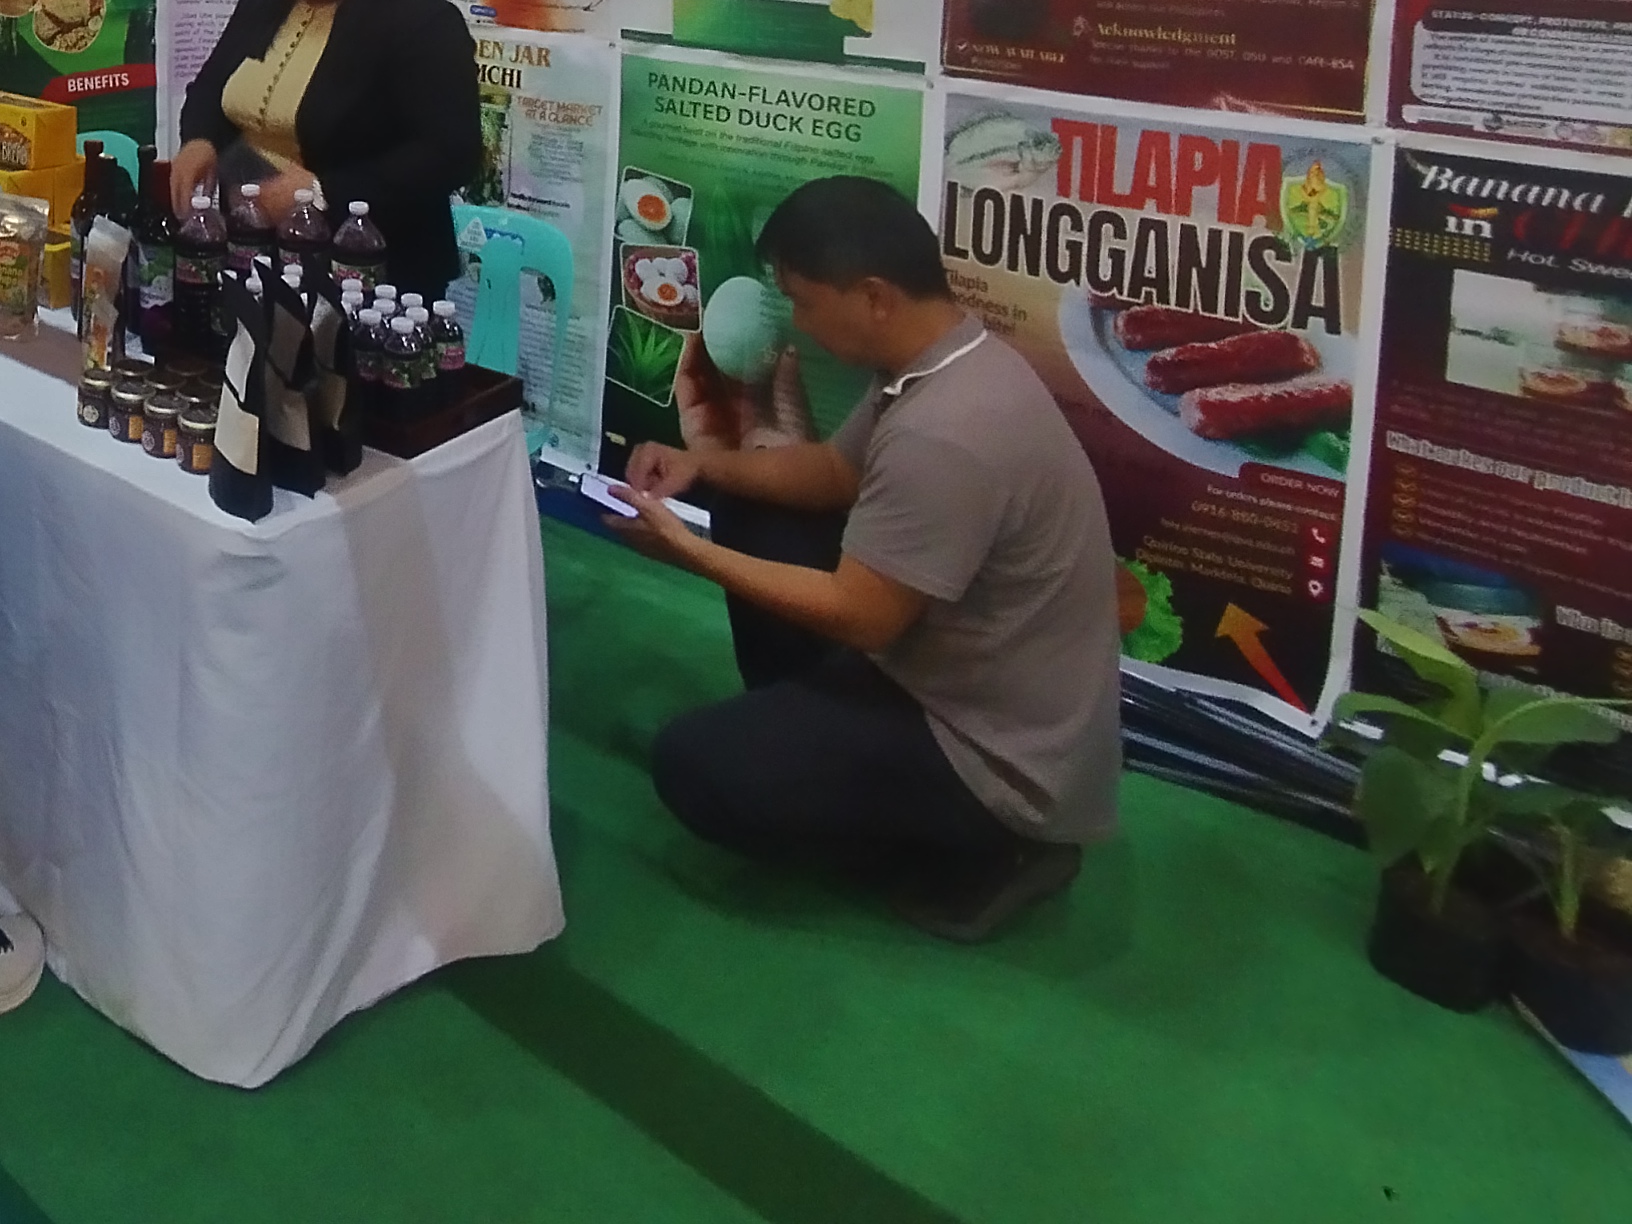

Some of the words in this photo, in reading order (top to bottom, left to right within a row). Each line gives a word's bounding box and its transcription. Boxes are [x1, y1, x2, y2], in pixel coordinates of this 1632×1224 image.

[510, 45, 551, 67] JAR
[68, 73, 130, 93] BENEFITS
[648, 72, 876, 118] PANDAN-FLAVORED
[539, 111, 546, 120] A
[654, 96, 731, 123] SALTED
[738, 108, 803, 134] DUCK
[812, 120, 862, 142] EGG
[736, 133, 781, 147] traditional
[1051, 117, 1283, 233] TILAPIA
[1421, 165, 1606, 214] Banana
[1444, 215, 1493, 239] in
[943, 181, 1342, 336] LONGGANISA
[1507, 248, 1560, 268] Hot
[1013, 304, 1027, 321] in
[1260, 473, 1304, 490] ORDER
[1307, 482, 1339, 499] NOW
